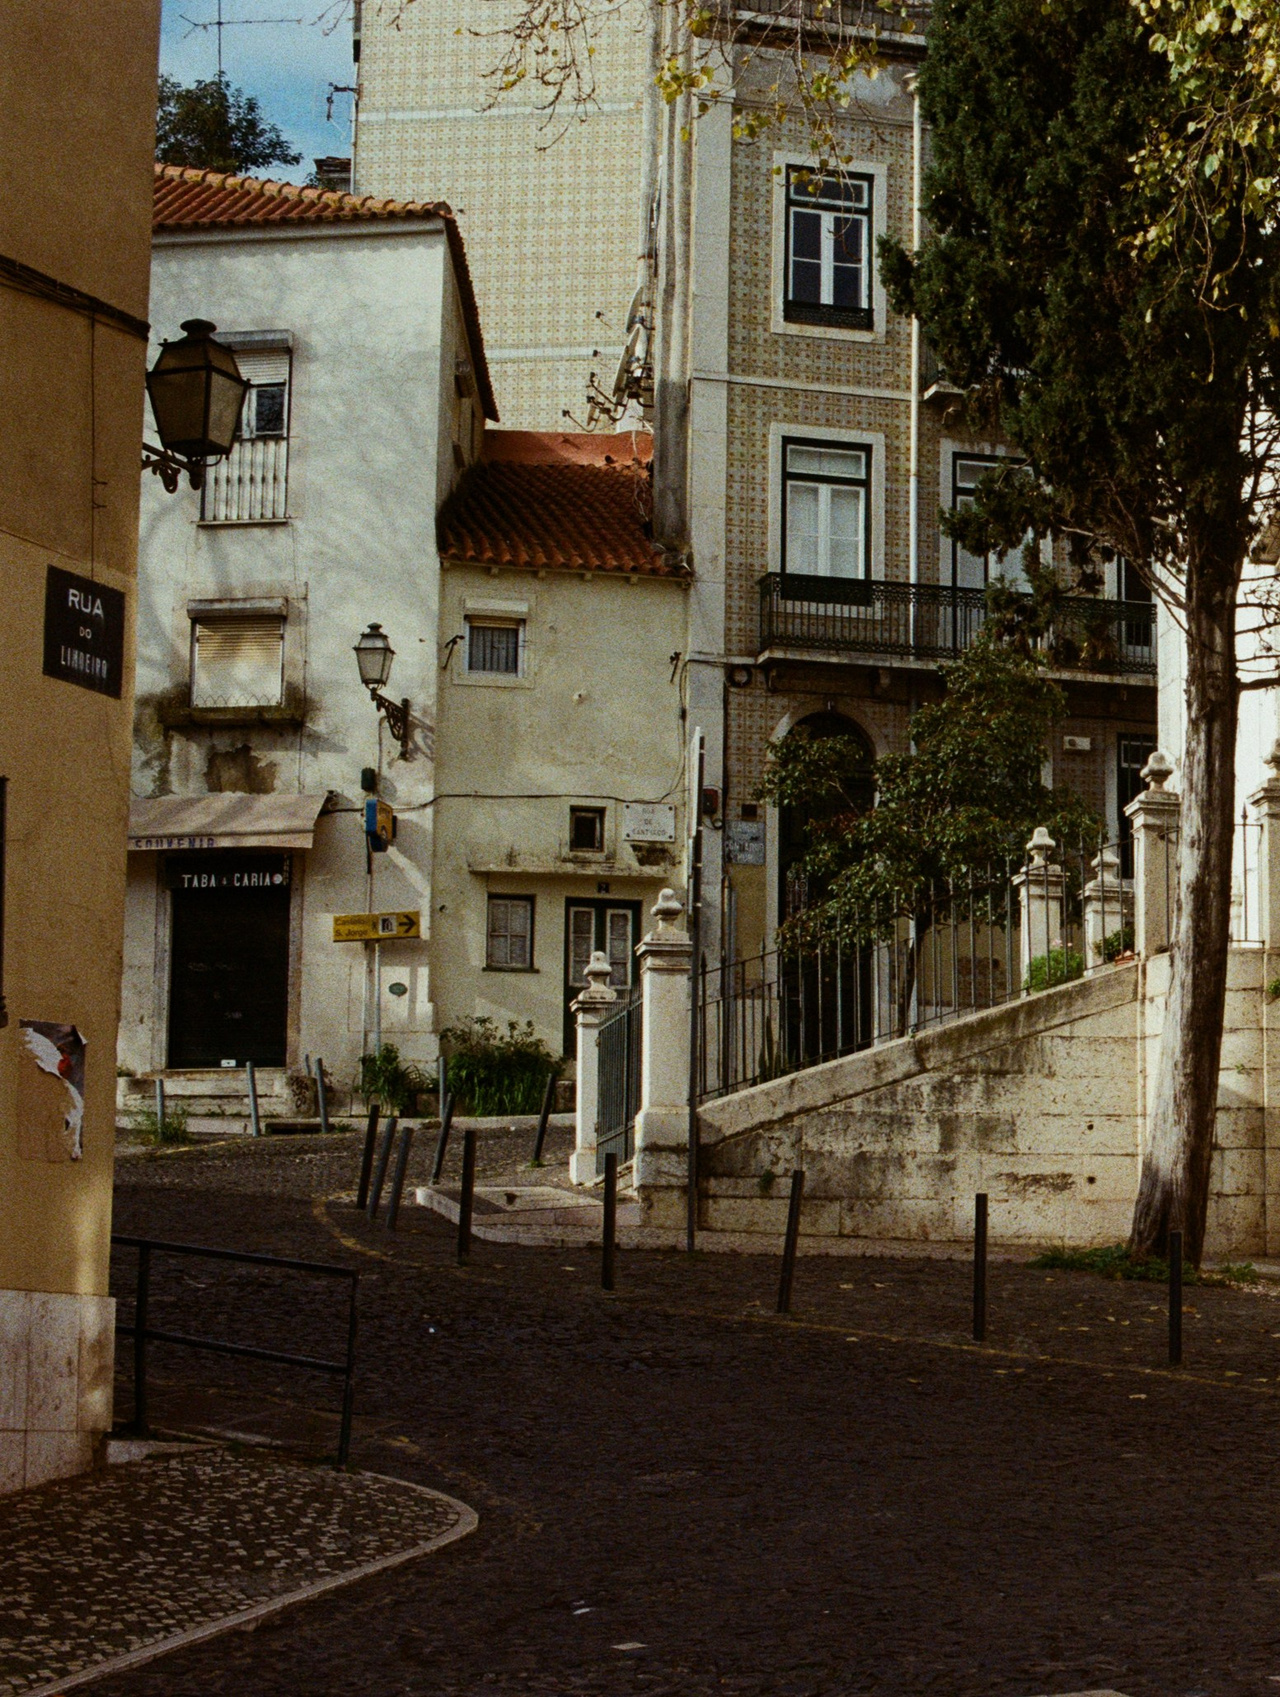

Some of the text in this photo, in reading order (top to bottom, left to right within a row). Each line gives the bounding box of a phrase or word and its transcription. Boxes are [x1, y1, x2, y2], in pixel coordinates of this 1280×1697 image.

[68, 588, 104, 619] RUA
[79, 626, 92, 640] DO
[61, 645, 108, 679] LIMOEIRO
[181, 872, 271, 888] TABA CARIA
